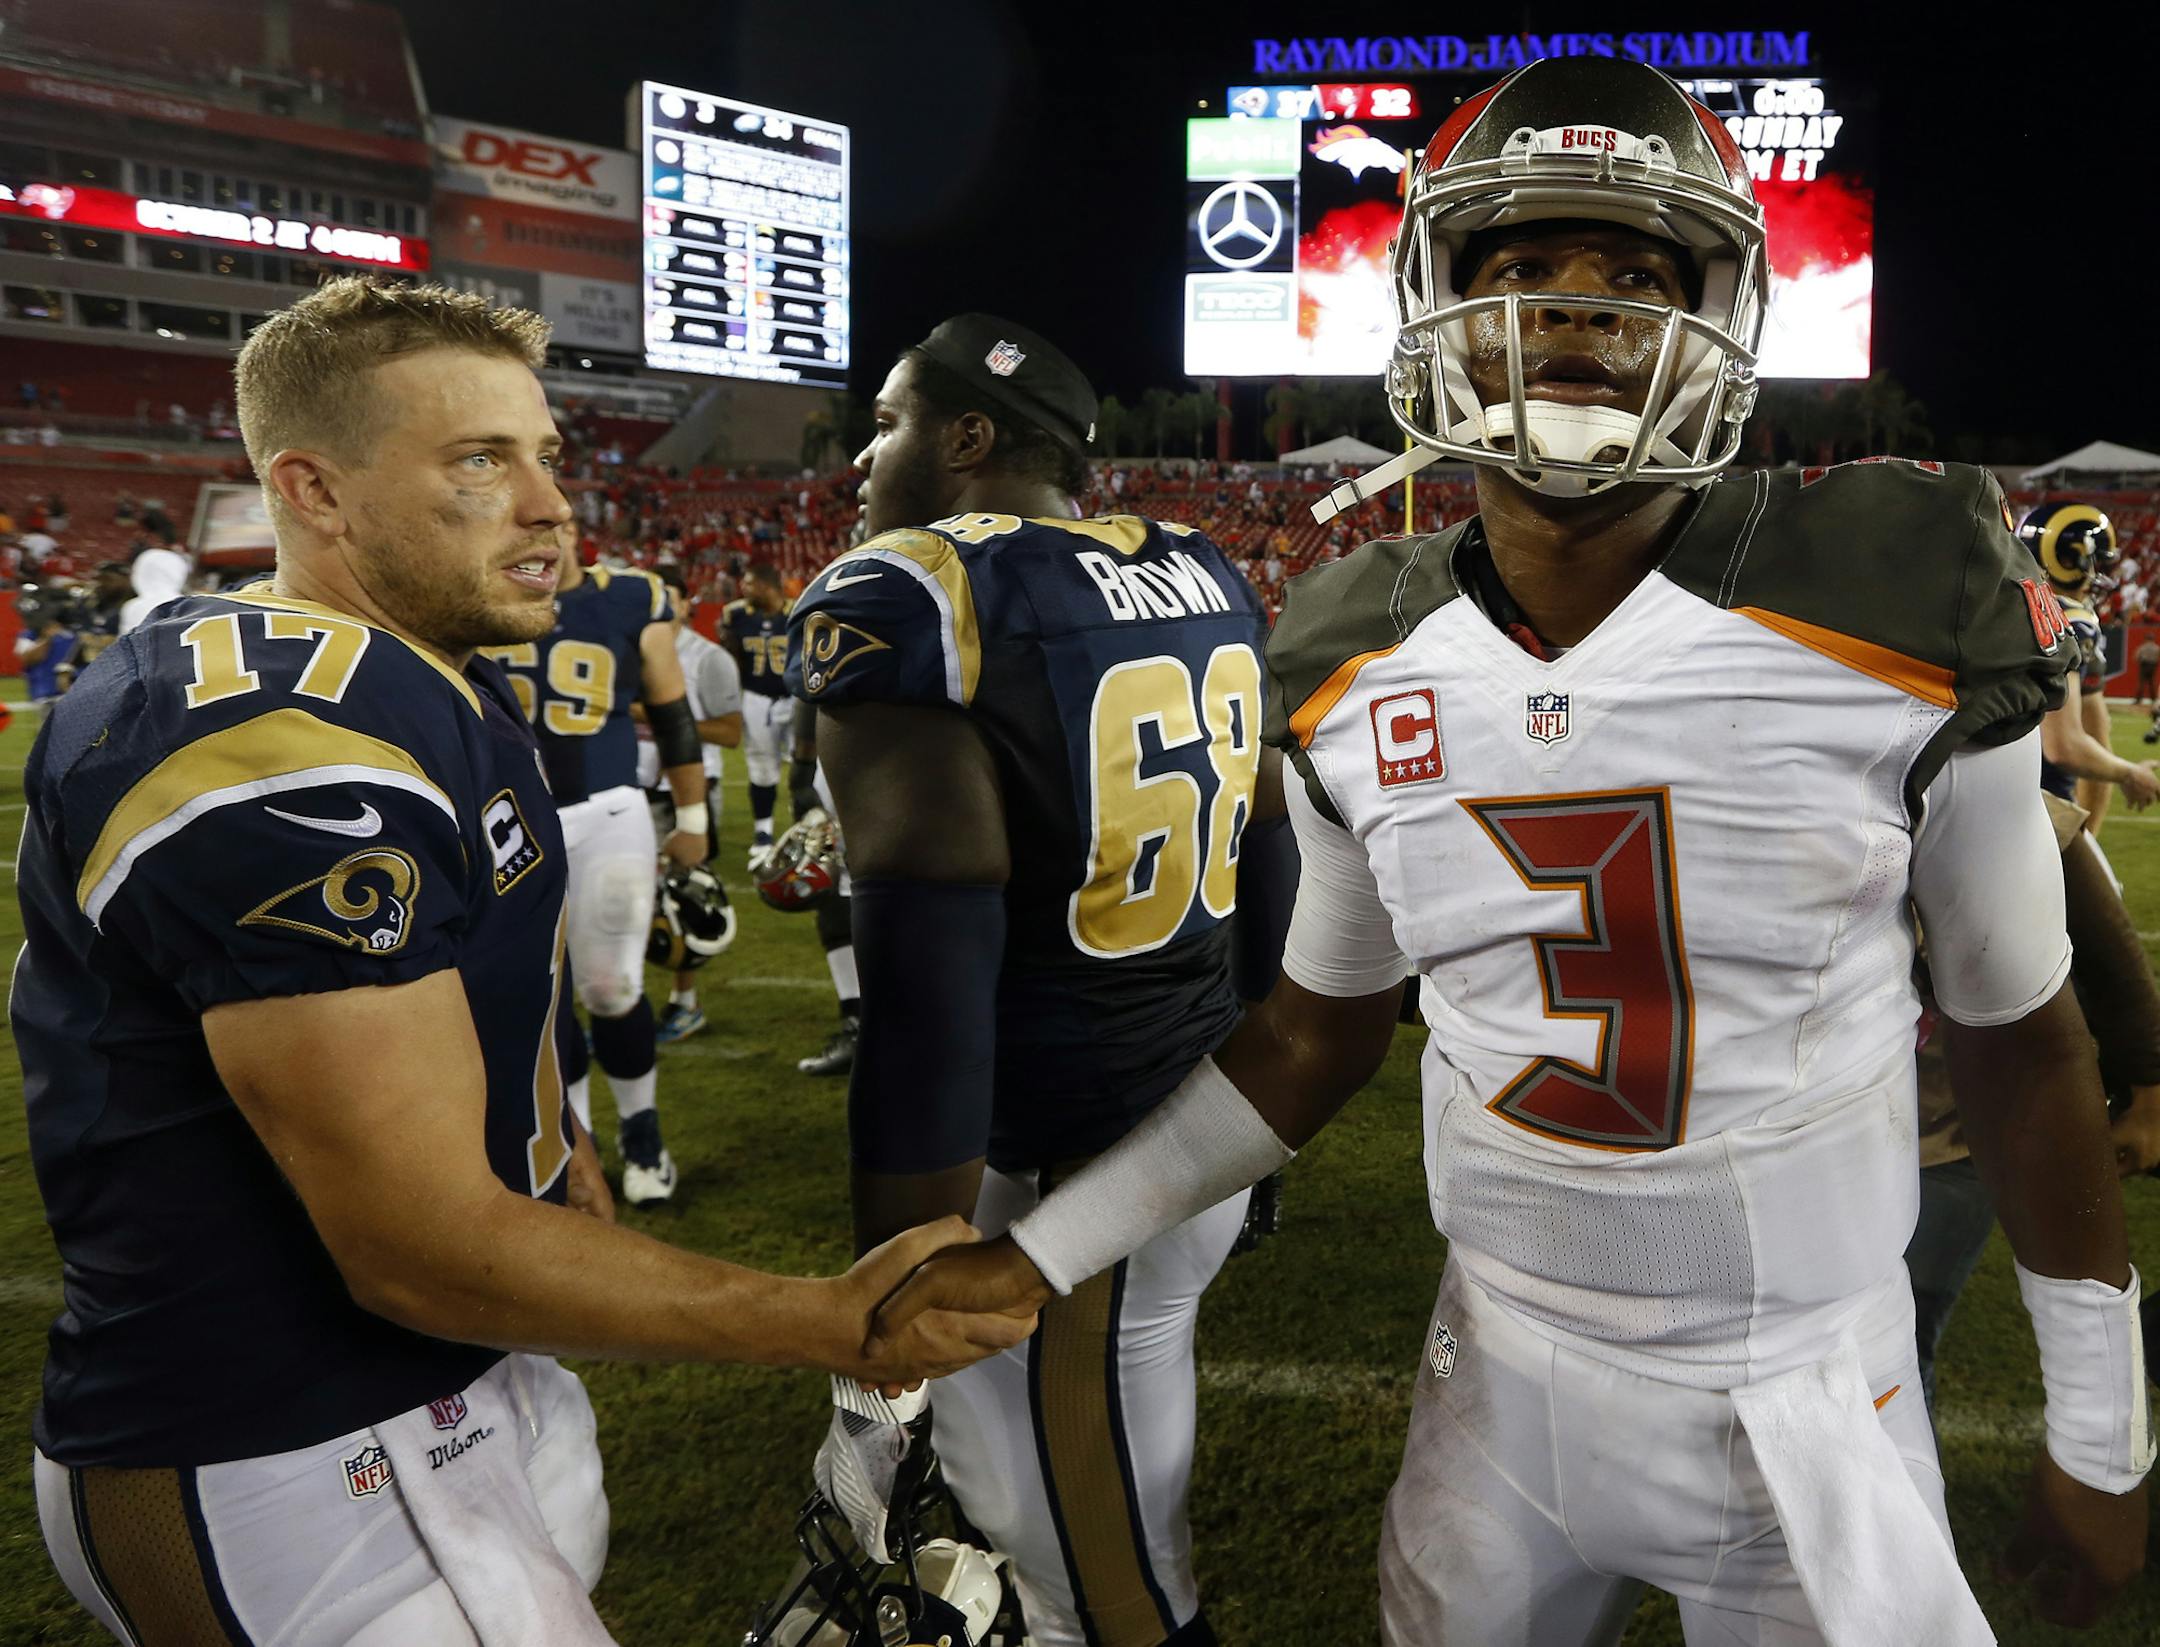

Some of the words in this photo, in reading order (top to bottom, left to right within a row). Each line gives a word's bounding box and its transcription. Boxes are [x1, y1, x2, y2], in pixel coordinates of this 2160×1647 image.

[1253, 36, 1468, 74] RAYMOND
[1621, 30, 1809, 67] STADIUM
[1753, 86, 1825, 116] 0:00
[1561, 128, 1617, 152] BUCS
[1726, 116, 1844, 149] SUNDAY
[462, 127, 604, 187] DEX
[1741, 150, 1775, 181] M
[180, 611, 372, 710] 17
[1376, 696, 1436, 762] C
[1530, 712, 1566, 737] NFL
[1067, 642, 1263, 960] 68
[488, 799, 525, 869] C
[1454, 786, 1695, 1153] 3
[427, 1428, 487, 1471] Wilson
[353, 1462, 391, 1493] NFL
